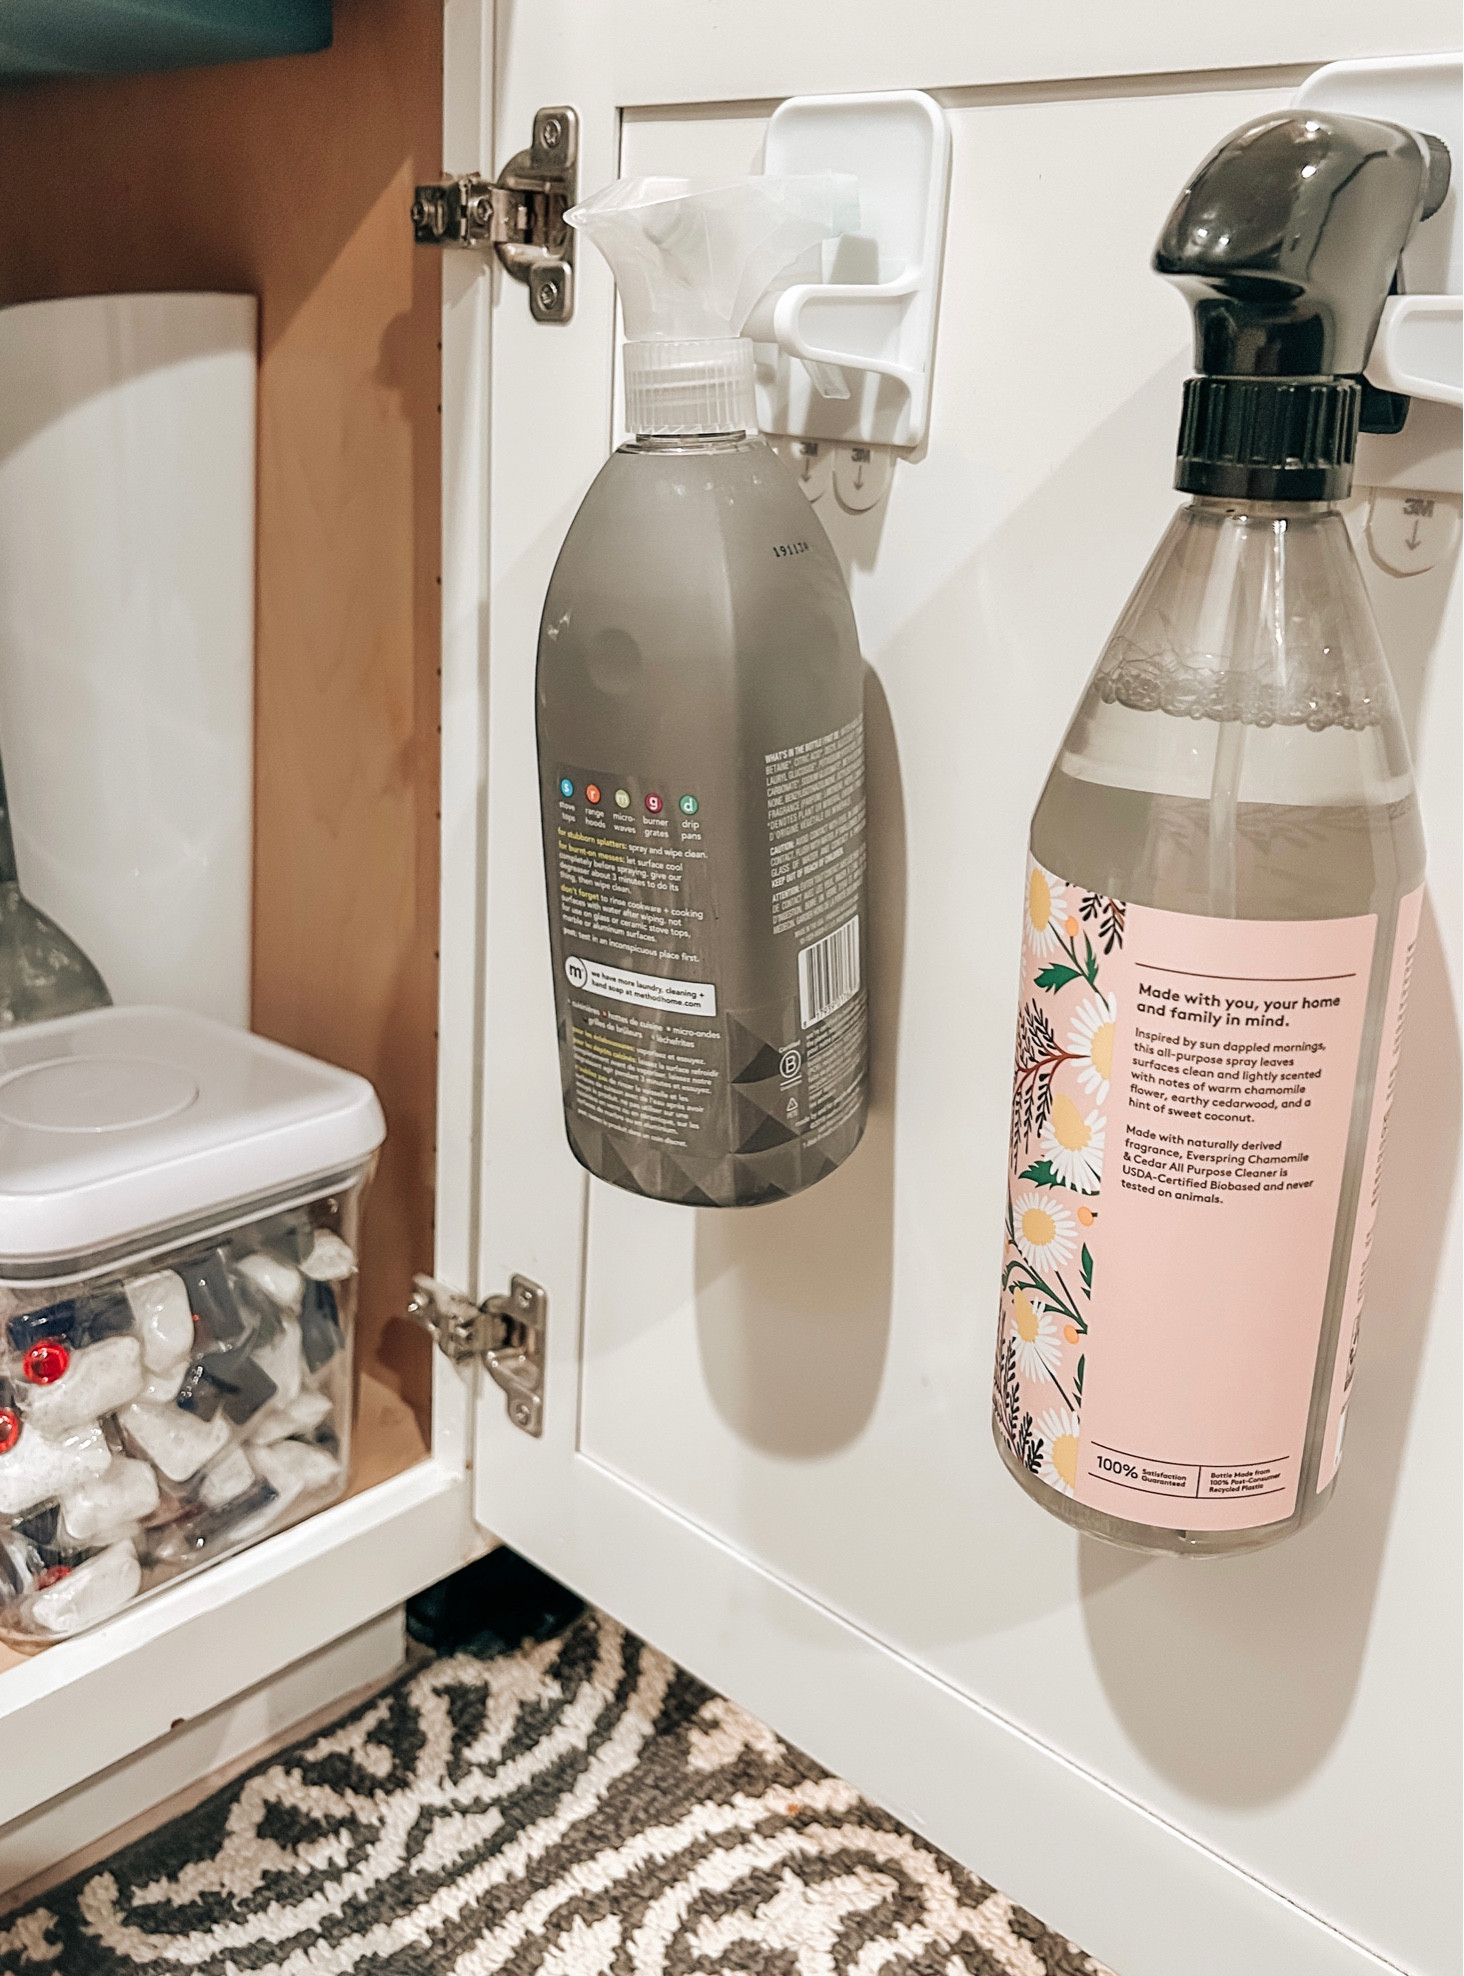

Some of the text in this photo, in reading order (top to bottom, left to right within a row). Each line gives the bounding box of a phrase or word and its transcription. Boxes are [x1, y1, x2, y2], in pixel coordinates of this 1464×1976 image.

[851, 447, 871, 464] 3M
[1403, 498, 1435, 518] 3M
[563, 783, 570, 792] s
[590, 790, 596, 799] r
[559, 801, 576, 812] stove
[617, 794, 629, 805] m
[649, 796, 658, 810] g
[683, 798, 693, 812] d
[561, 812, 576, 823] tops
[585, 807, 605, 818] range
[585, 817, 606, 829] hoods
[612, 812, 635, 822] micro-
[642, 815, 669, 827] burner
[613, 824, 636, 834] waves
[644, 828, 669, 839] grates
[681, 820, 700, 831] drip
[557, 826, 708, 859] for stubborn splatters: spray and wipe clean.
[681, 831, 702, 842] pans
[558, 840, 567, 850] for
[626, 856, 636, 865] let
[637, 858, 664, 870] surface
[665, 862, 683, 872] cool
[591, 869, 679, 892] about 3 minutes to do its
[593, 859, 682, 882] before spraying. give our
[578, 875, 611, 891] then wipe
[578, 888, 600, 901] forget
[600, 894, 609, 903] to
[609, 896, 626, 907] rinse
[627, 900, 662, 914] cookware
[670, 908, 704, 921] cooking
[587, 900, 682, 927] with water after wiping. not
[561, 902, 691, 939] for use on glass or ceramic stove tops,
[593, 919, 626, 937] aluminum
[626, 930, 657, 943] surfaces.
[608, 938, 658, 957] inconspicuous
[659, 948, 680, 960] place
[681, 952, 700, 962] first.
[569, 964, 583, 980] m
[591, 979, 607, 990] hand
[608, 984, 624, 995] soap
[634, 991, 701, 1008] methodhome.com
[601, 972, 617, 983] have
[618, 977, 635, 987] more
[665, 987, 697, 1000] cleaning
[1139, 983, 1341, 1012] Made with you, your home
[1136, 1001, 1290, 1028] and family in mind.
[672, 1025, 721, 1039] micro-ondes
[1135, 1027, 1327, 1054] Inspired by sun dappled mornings,
[1134, 1042, 1295, 1069] this all-purpose spray leaves
[1132, 1057, 1322, 1084] surfaces clean and lightly scented
[1131, 1070, 1306, 1095] with notes of warm chamomile
[1130, 1083, 1311, 1110] flower, earthy cedarwood, and a
[1128, 1097, 1255, 1123] hint of sweet coconut.
[1126, 1124, 1282, 1152] Made with naturally derived
[1124, 1138, 1310, 1166] fragrance, Everspring Chamomile
[1123, 1151, 1288, 1178] & Cedar All Purpose Cleaner is
[1122, 1164, 1314, 1192] USDA-Certified Biobased and never
[1120, 1178, 1224, 1204] tested on animals.
[1097, 1455, 1139, 1480] 100%
[1141, 1468, 1187, 1481] Satisfaction
[1210, 1468, 1271, 1479] Bottle Made from
[1141, 1475, 1186, 1488] Guaranteed
[1208, 1483, 1264, 1494] Recycled Plastic
[1230, 1472, 1281, 1485] Post-Consumer
